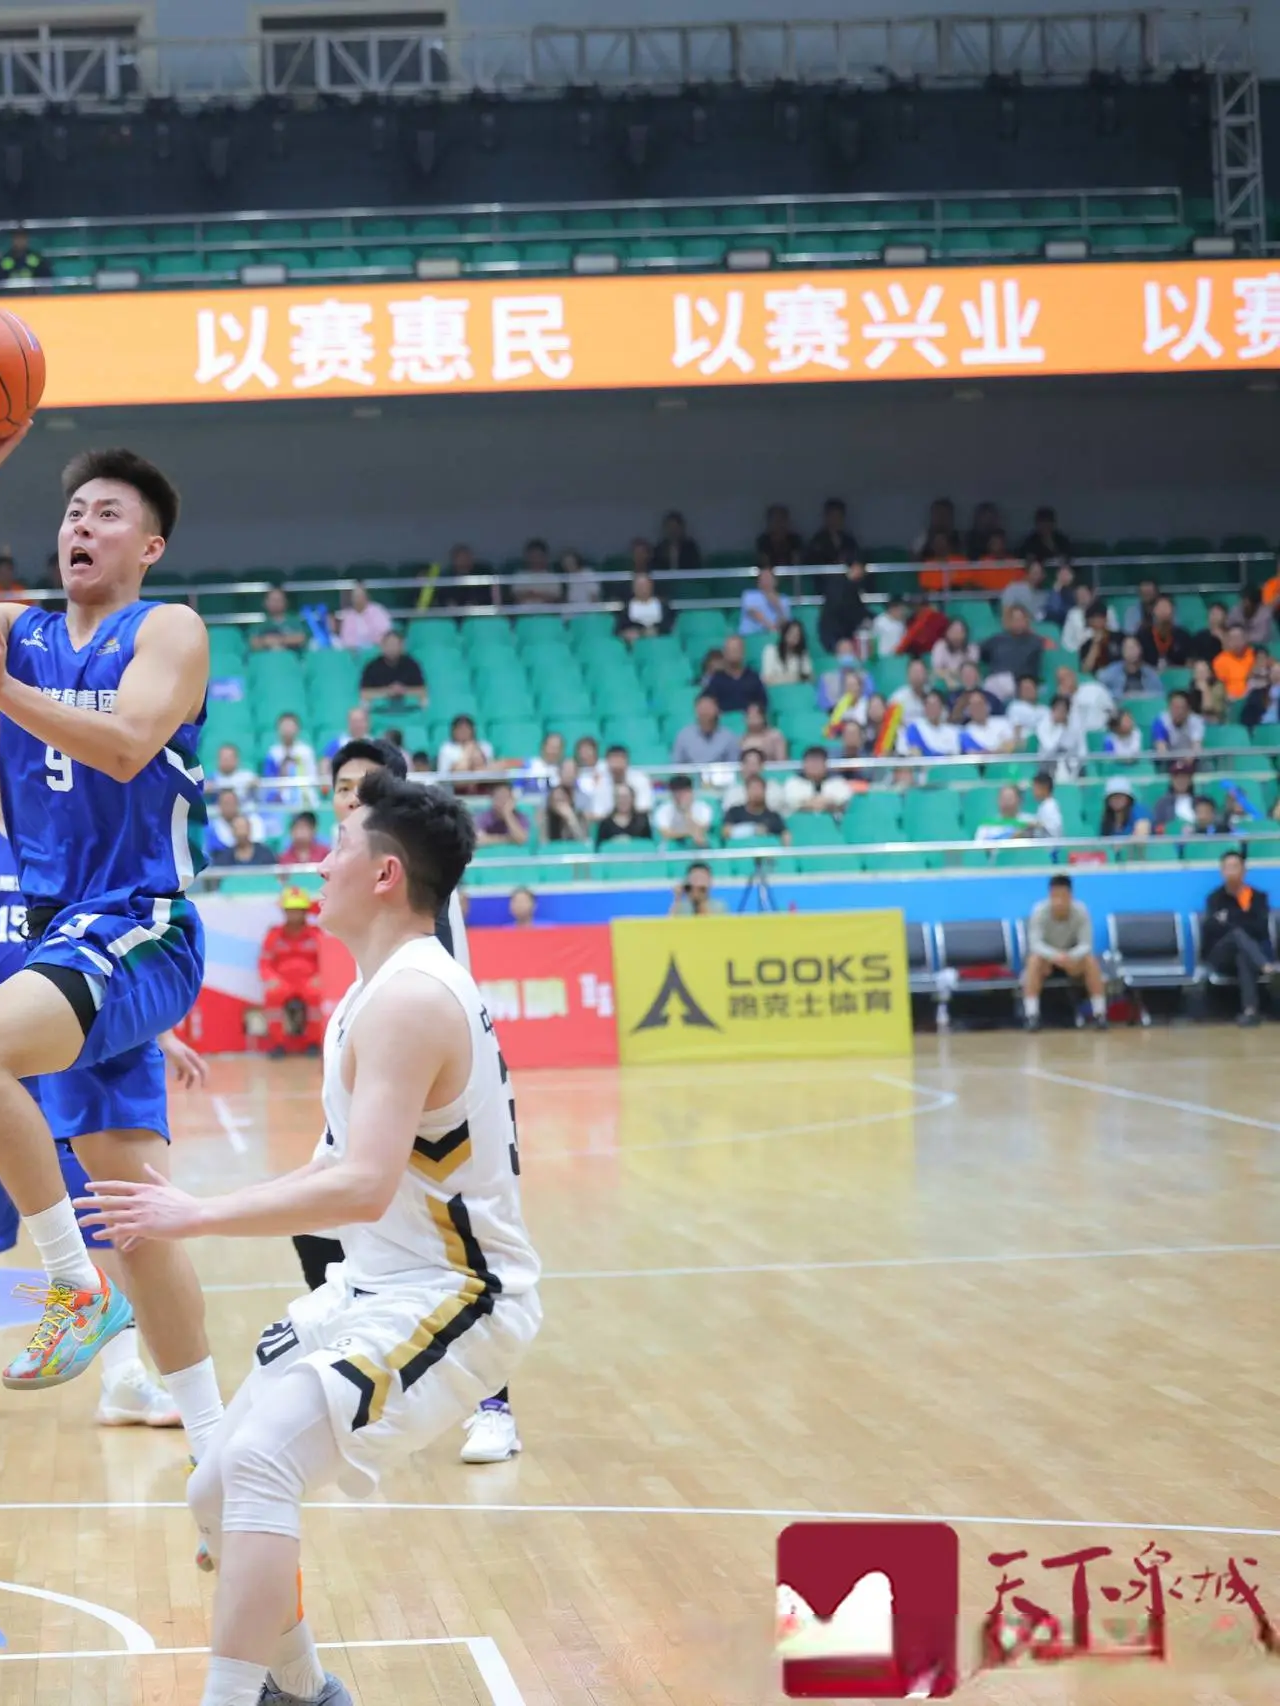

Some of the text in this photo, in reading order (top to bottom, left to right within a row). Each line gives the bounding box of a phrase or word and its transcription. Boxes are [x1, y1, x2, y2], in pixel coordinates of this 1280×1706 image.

[194, 293, 575, 392] 以赛惠民
[671, 279, 1046, 376] 以赛兴业
[45, 744, 74, 793] 9
[726, 953, 893, 987] LOOKS
